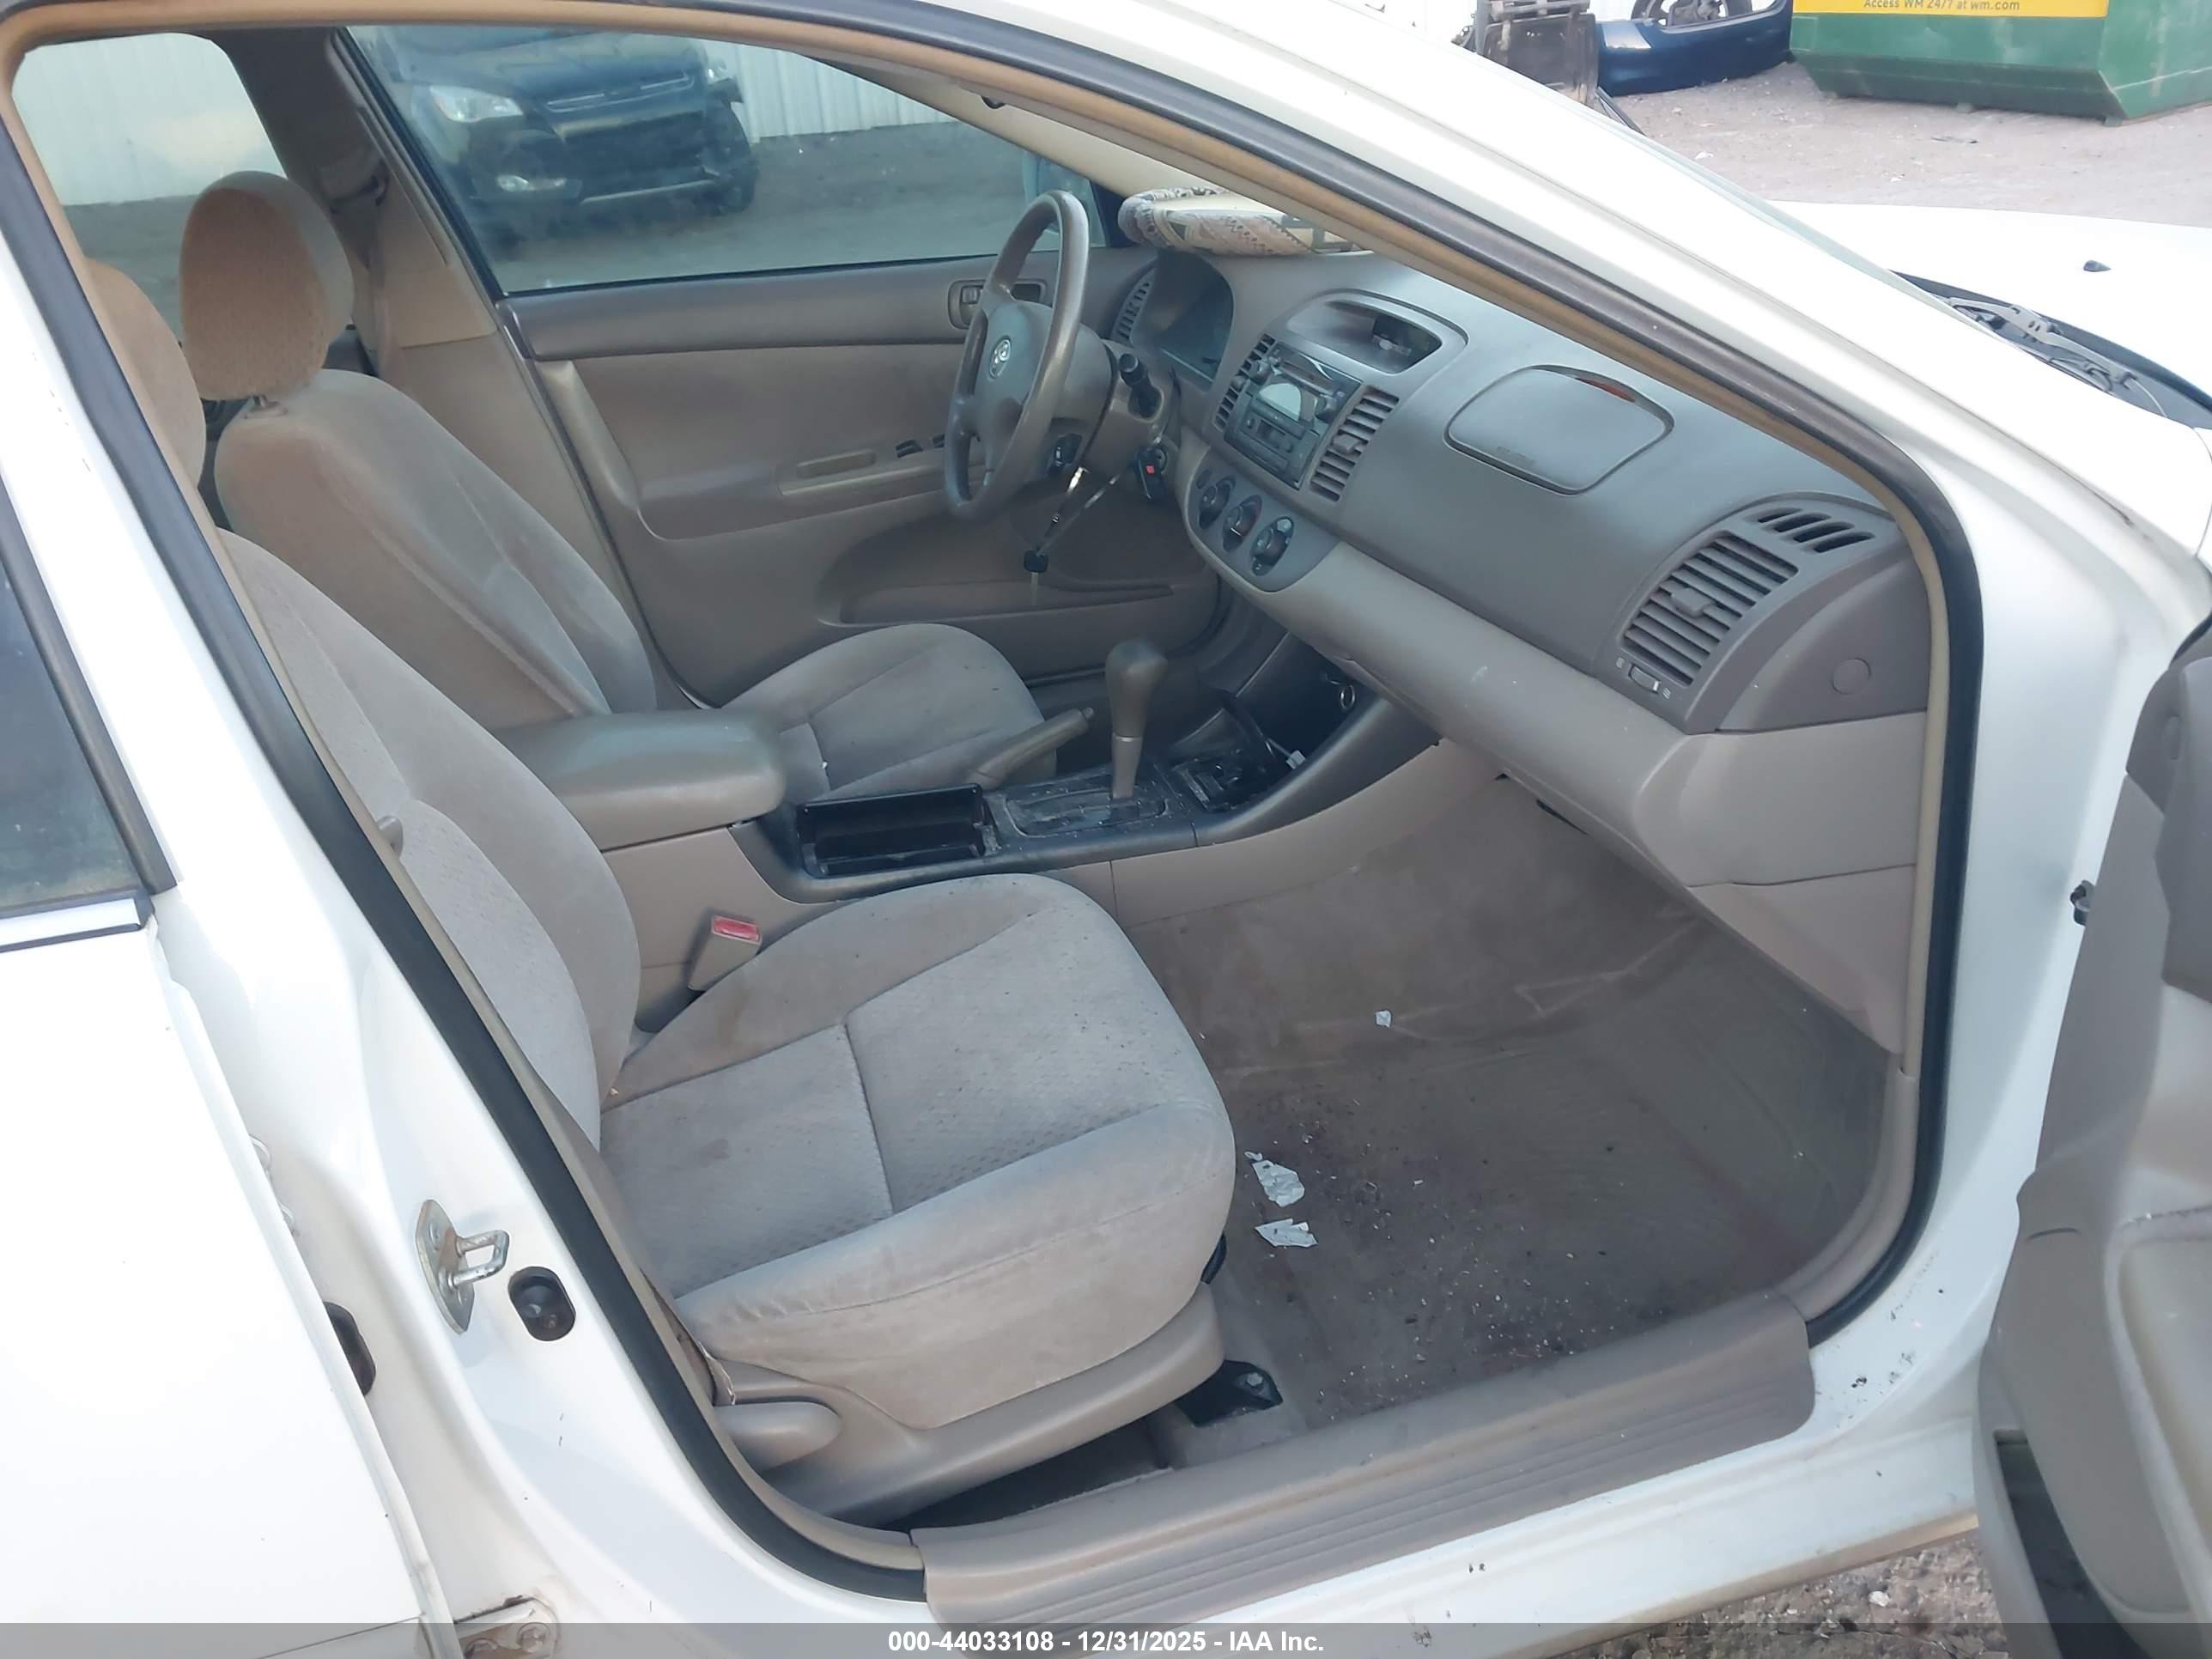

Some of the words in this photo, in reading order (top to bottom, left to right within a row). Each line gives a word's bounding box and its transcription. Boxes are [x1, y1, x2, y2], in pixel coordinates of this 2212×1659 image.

[1926, 0, 1952, 9] 24/7
[1957, 0, 1966, 9] at
[1971, 1, 2020, 10] wm.com
